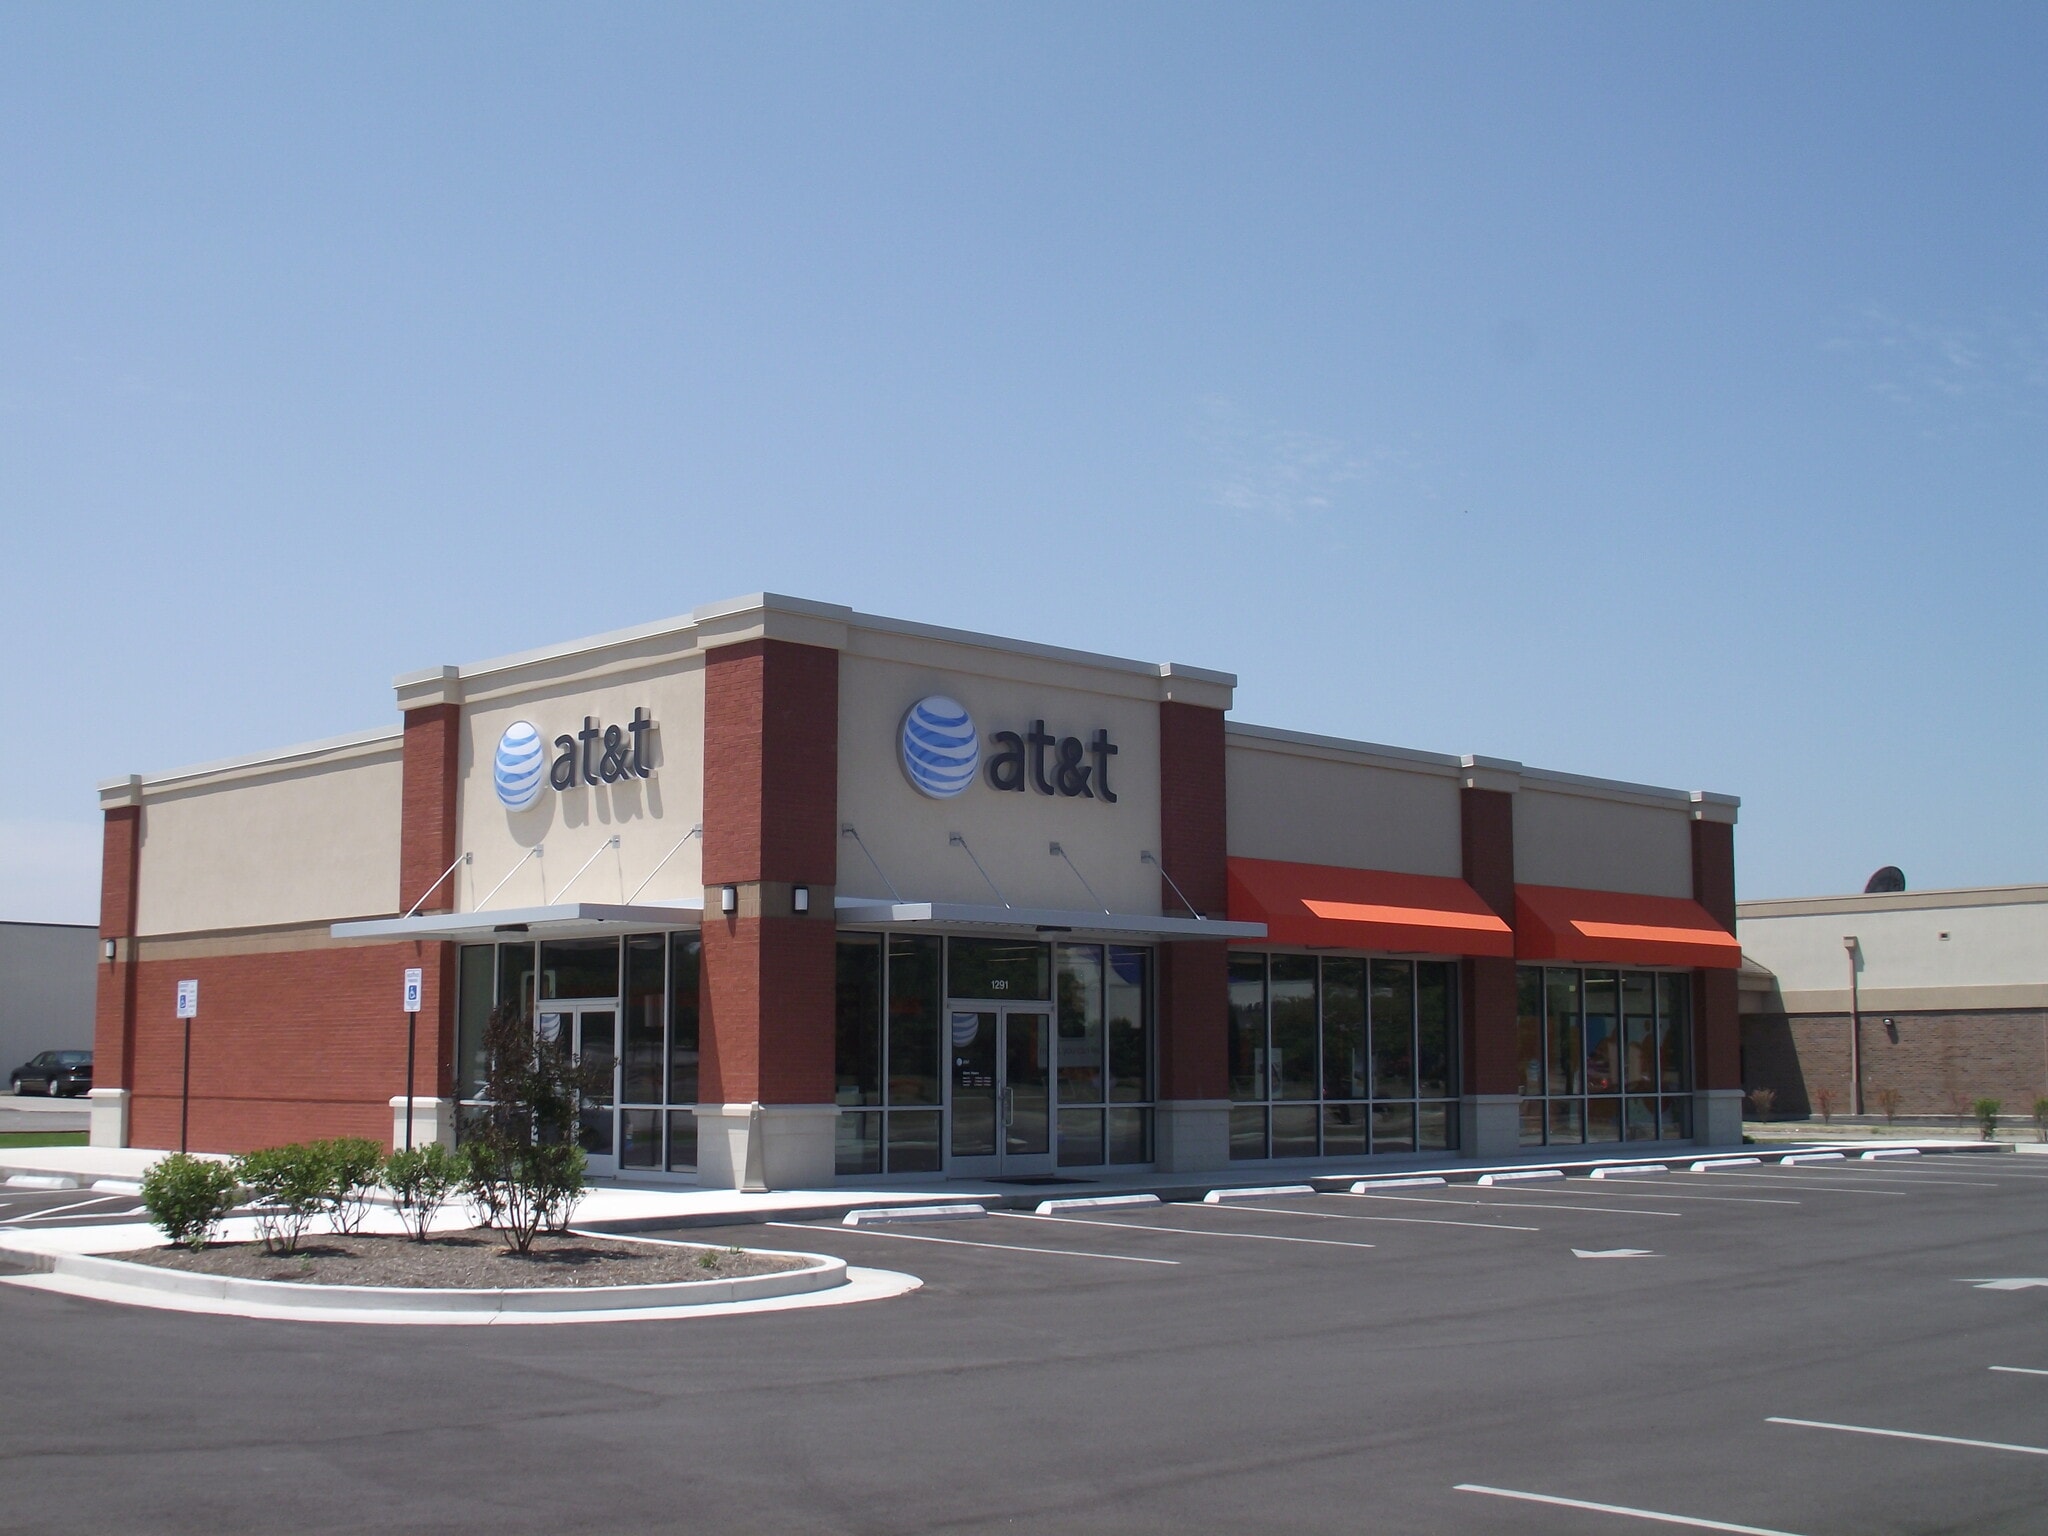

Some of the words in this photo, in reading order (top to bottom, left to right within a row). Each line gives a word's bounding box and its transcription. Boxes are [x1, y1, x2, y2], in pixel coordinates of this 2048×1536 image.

[550, 706, 655, 791] at&t
[985, 719, 1118, 803] at&t
[991, 979, 1009, 990] 1291
